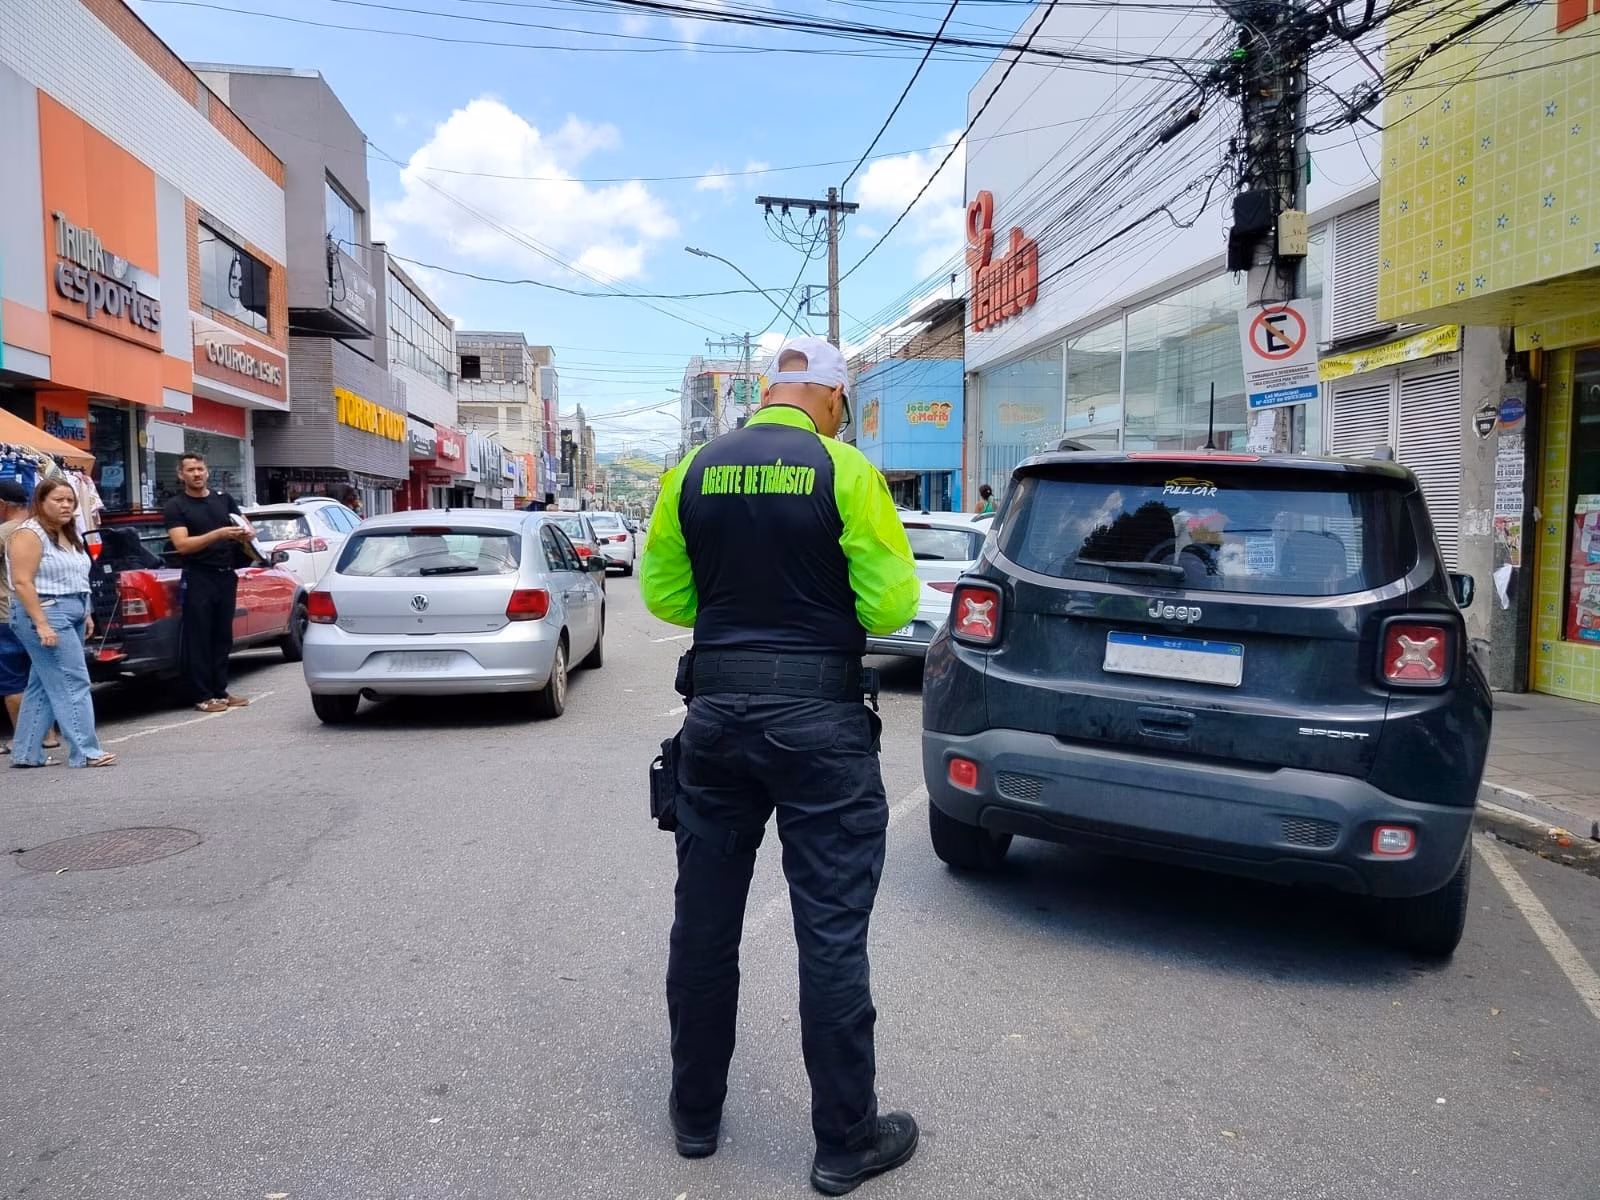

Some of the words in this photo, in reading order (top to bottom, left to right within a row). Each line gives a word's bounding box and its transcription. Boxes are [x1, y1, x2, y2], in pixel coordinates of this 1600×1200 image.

[53, 210, 105, 274] TRILHA
[907, 401, 930, 414] João
[919, 412, 949, 422] Maria
[701, 465, 743, 495] AGENTE
[744, 465, 760, 494] DE
[1163, 485, 1191, 495] FULL
[1191, 486, 1218, 497] CAR
[1148, 600, 1202, 624] Jeep
[1299, 727, 1370, 740] SPORT
